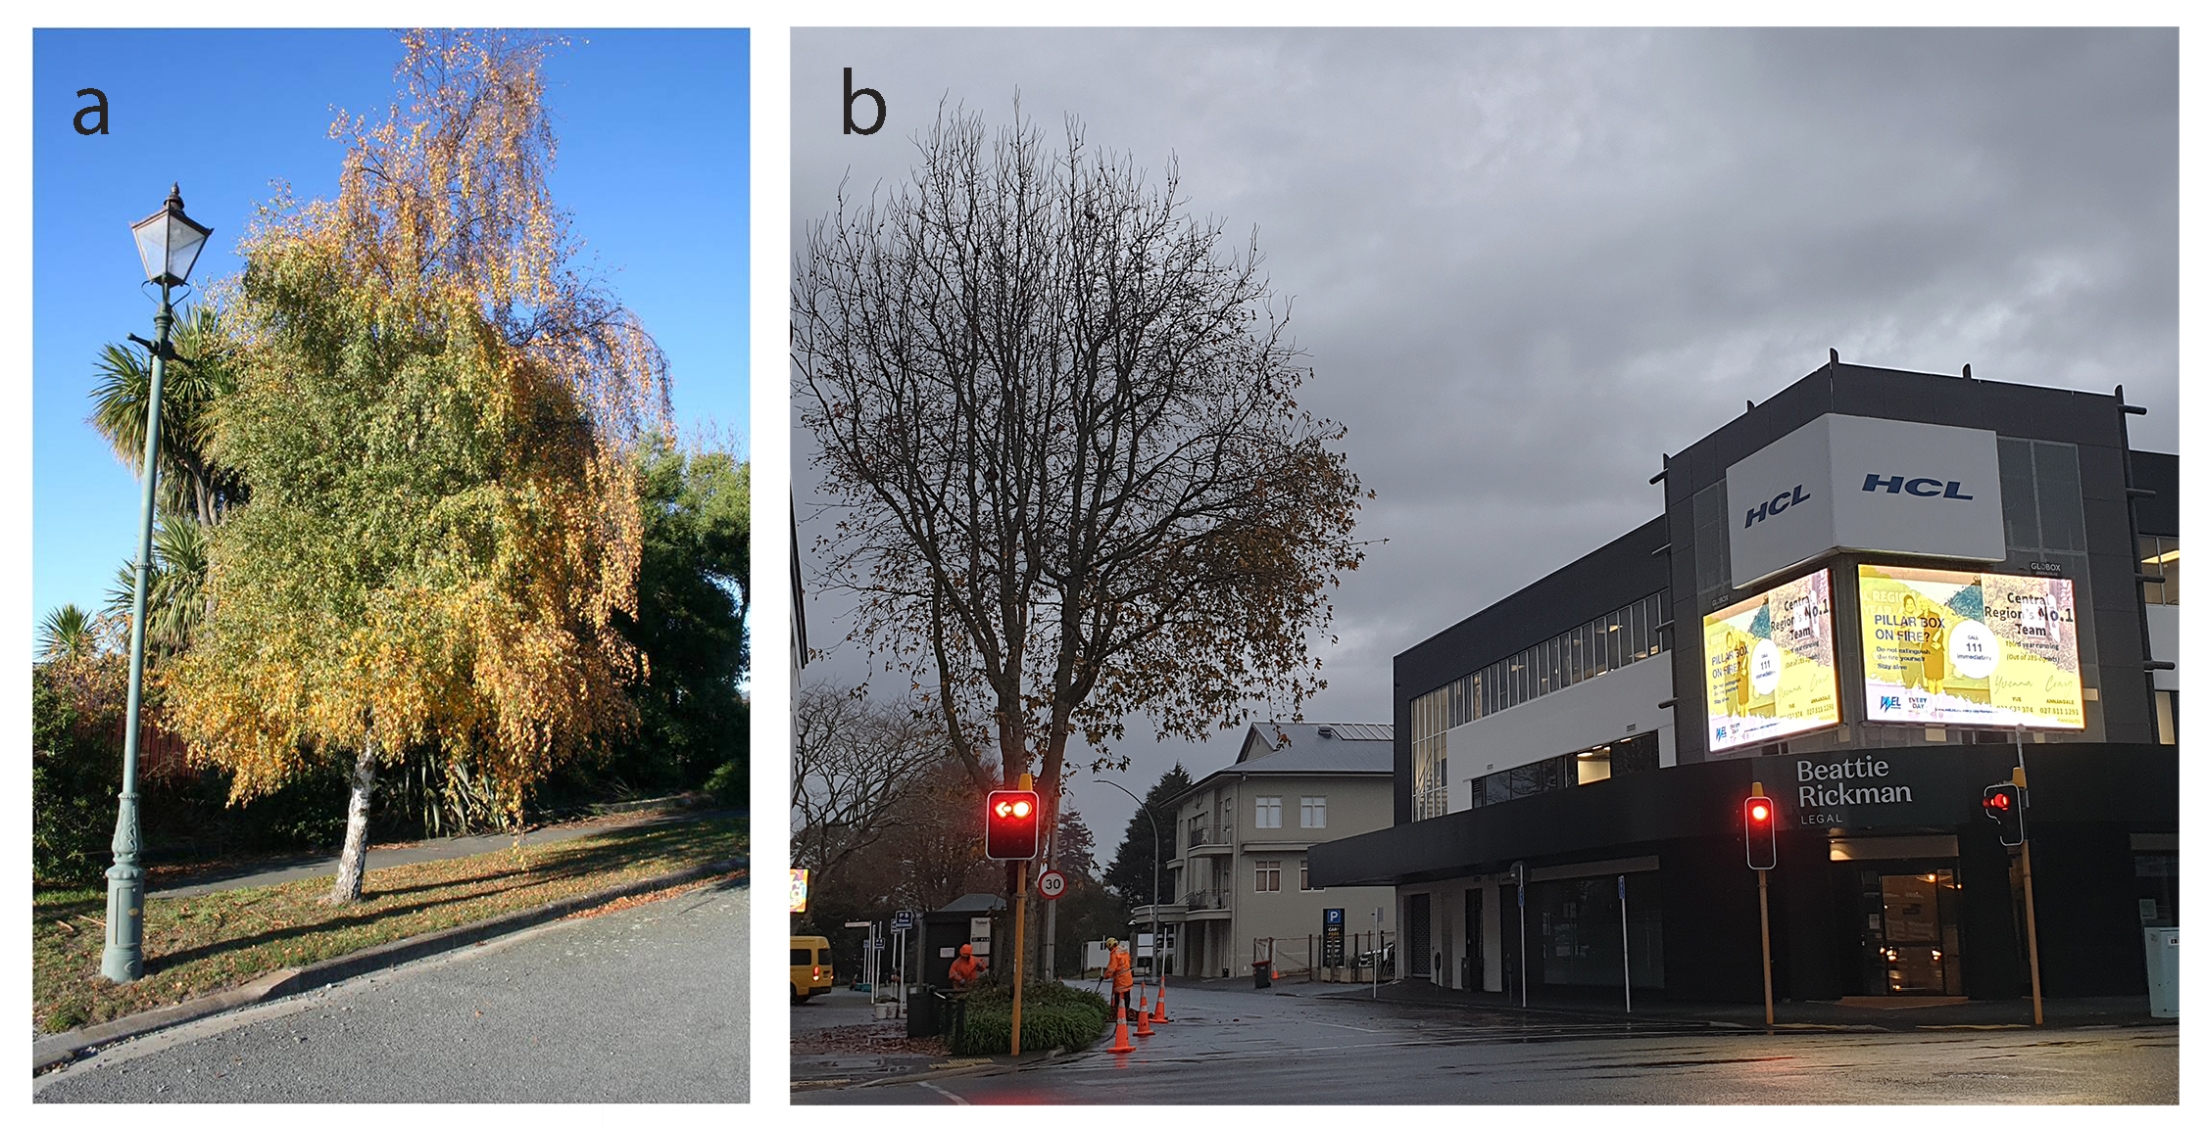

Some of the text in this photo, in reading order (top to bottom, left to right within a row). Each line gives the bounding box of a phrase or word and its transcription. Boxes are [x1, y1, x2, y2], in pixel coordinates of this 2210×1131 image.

[1862, 473, 1973, 500] HCL
[1744, 484, 1811, 528] HCL
[2030, 562, 2061, 571] GLOBOX
[2007, 592, 2050, 605] Central
[1874, 614, 1945, 629] PILLAR BOX
[1789, 627, 1811, 640] Team
[1875, 628, 1930, 643] ON FIRE?
[2015, 623, 2046, 636] Team
[1965, 643, 1983, 653] 111
[1712, 668, 1723, 679] ON
[1797, 755, 1890, 782] Beattie
[1798, 782, 1912, 807] Rickman
[1801, 813, 1843, 825] LEGAL
[1045, 879, 1060, 890] 30
[1330, 911, 1338, 922] P
